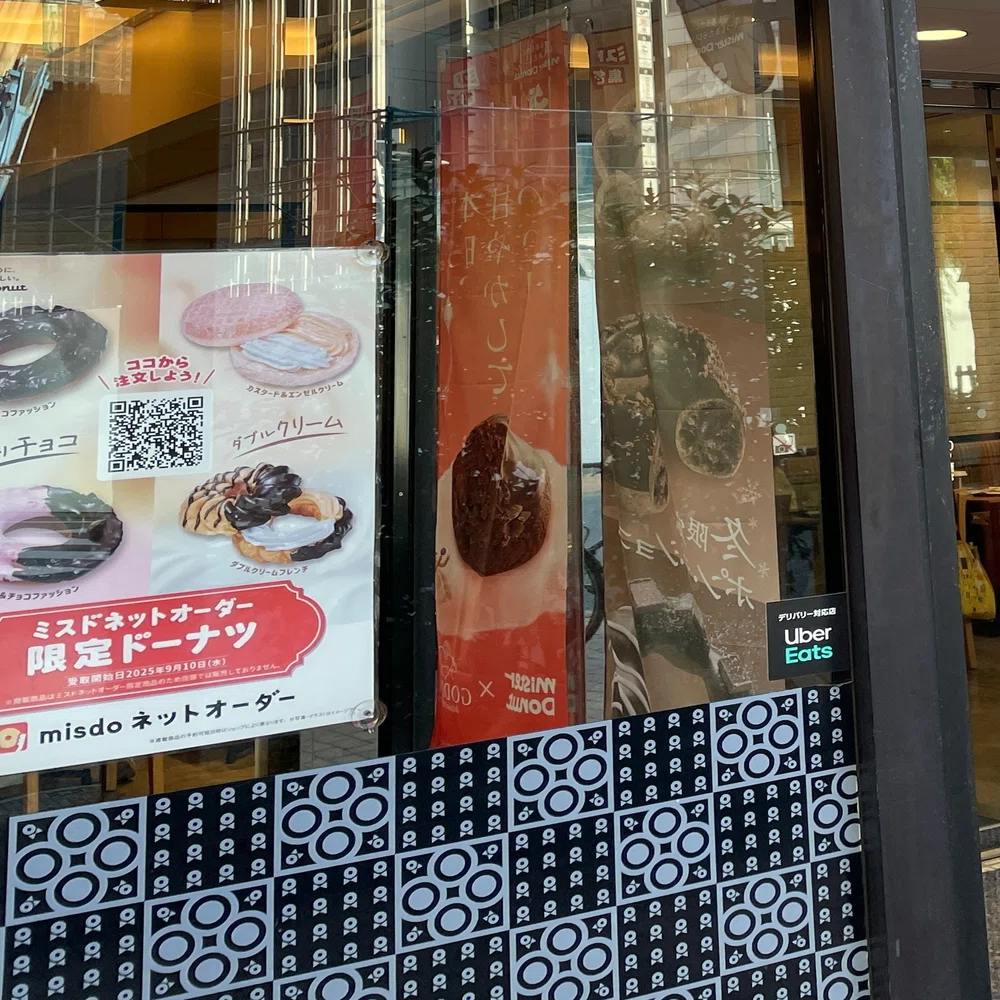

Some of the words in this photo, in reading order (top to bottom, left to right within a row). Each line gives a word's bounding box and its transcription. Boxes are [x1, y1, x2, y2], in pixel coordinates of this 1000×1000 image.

[126, 355, 190, 372] ココから
[232, 414, 344, 451] ダブルクリーム
[229, 560, 309, 578] ダブルクリームフレンチ
[32, 598, 254, 641] ミスドネットオーダー
[777, 607, 837, 622] デリバリー対応店
[784, 627, 832, 645] Uber
[26, 621, 258, 677] 限定ドーナツ
[785, 644, 833, 665] Eats
[67, 657, 227, 687] 受取開始日2025年9月10日(水)
[39, 717, 123, 744] misdo
[131, 688, 296, 731] ネットオーダー
